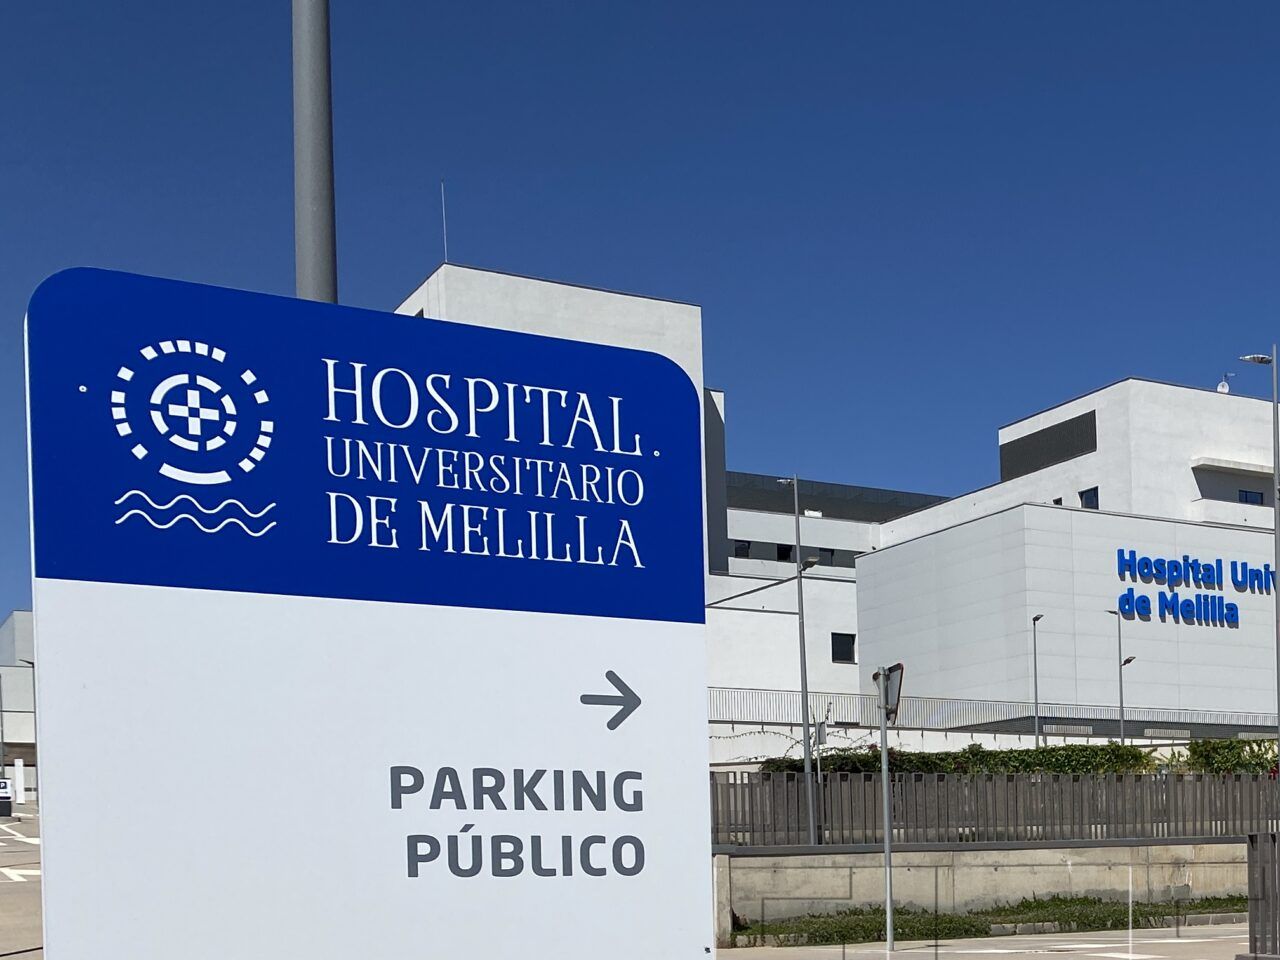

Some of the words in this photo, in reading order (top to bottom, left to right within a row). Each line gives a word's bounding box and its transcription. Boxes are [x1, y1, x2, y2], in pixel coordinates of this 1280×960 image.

[321, 357, 643, 457] HOSPITAL
[324, 435, 645, 507] UNIVERSITARIO
[325, 491, 399, 549] DE
[417, 500, 646, 569] MELILLA
[1117, 549, 1223, 591] Hospital
[1119, 588, 1151, 619] de
[1158, 591, 1239, 627] Melilla
[389, 765, 644, 813] PARKING
[406, 823, 646, 878] PÚBLICO
